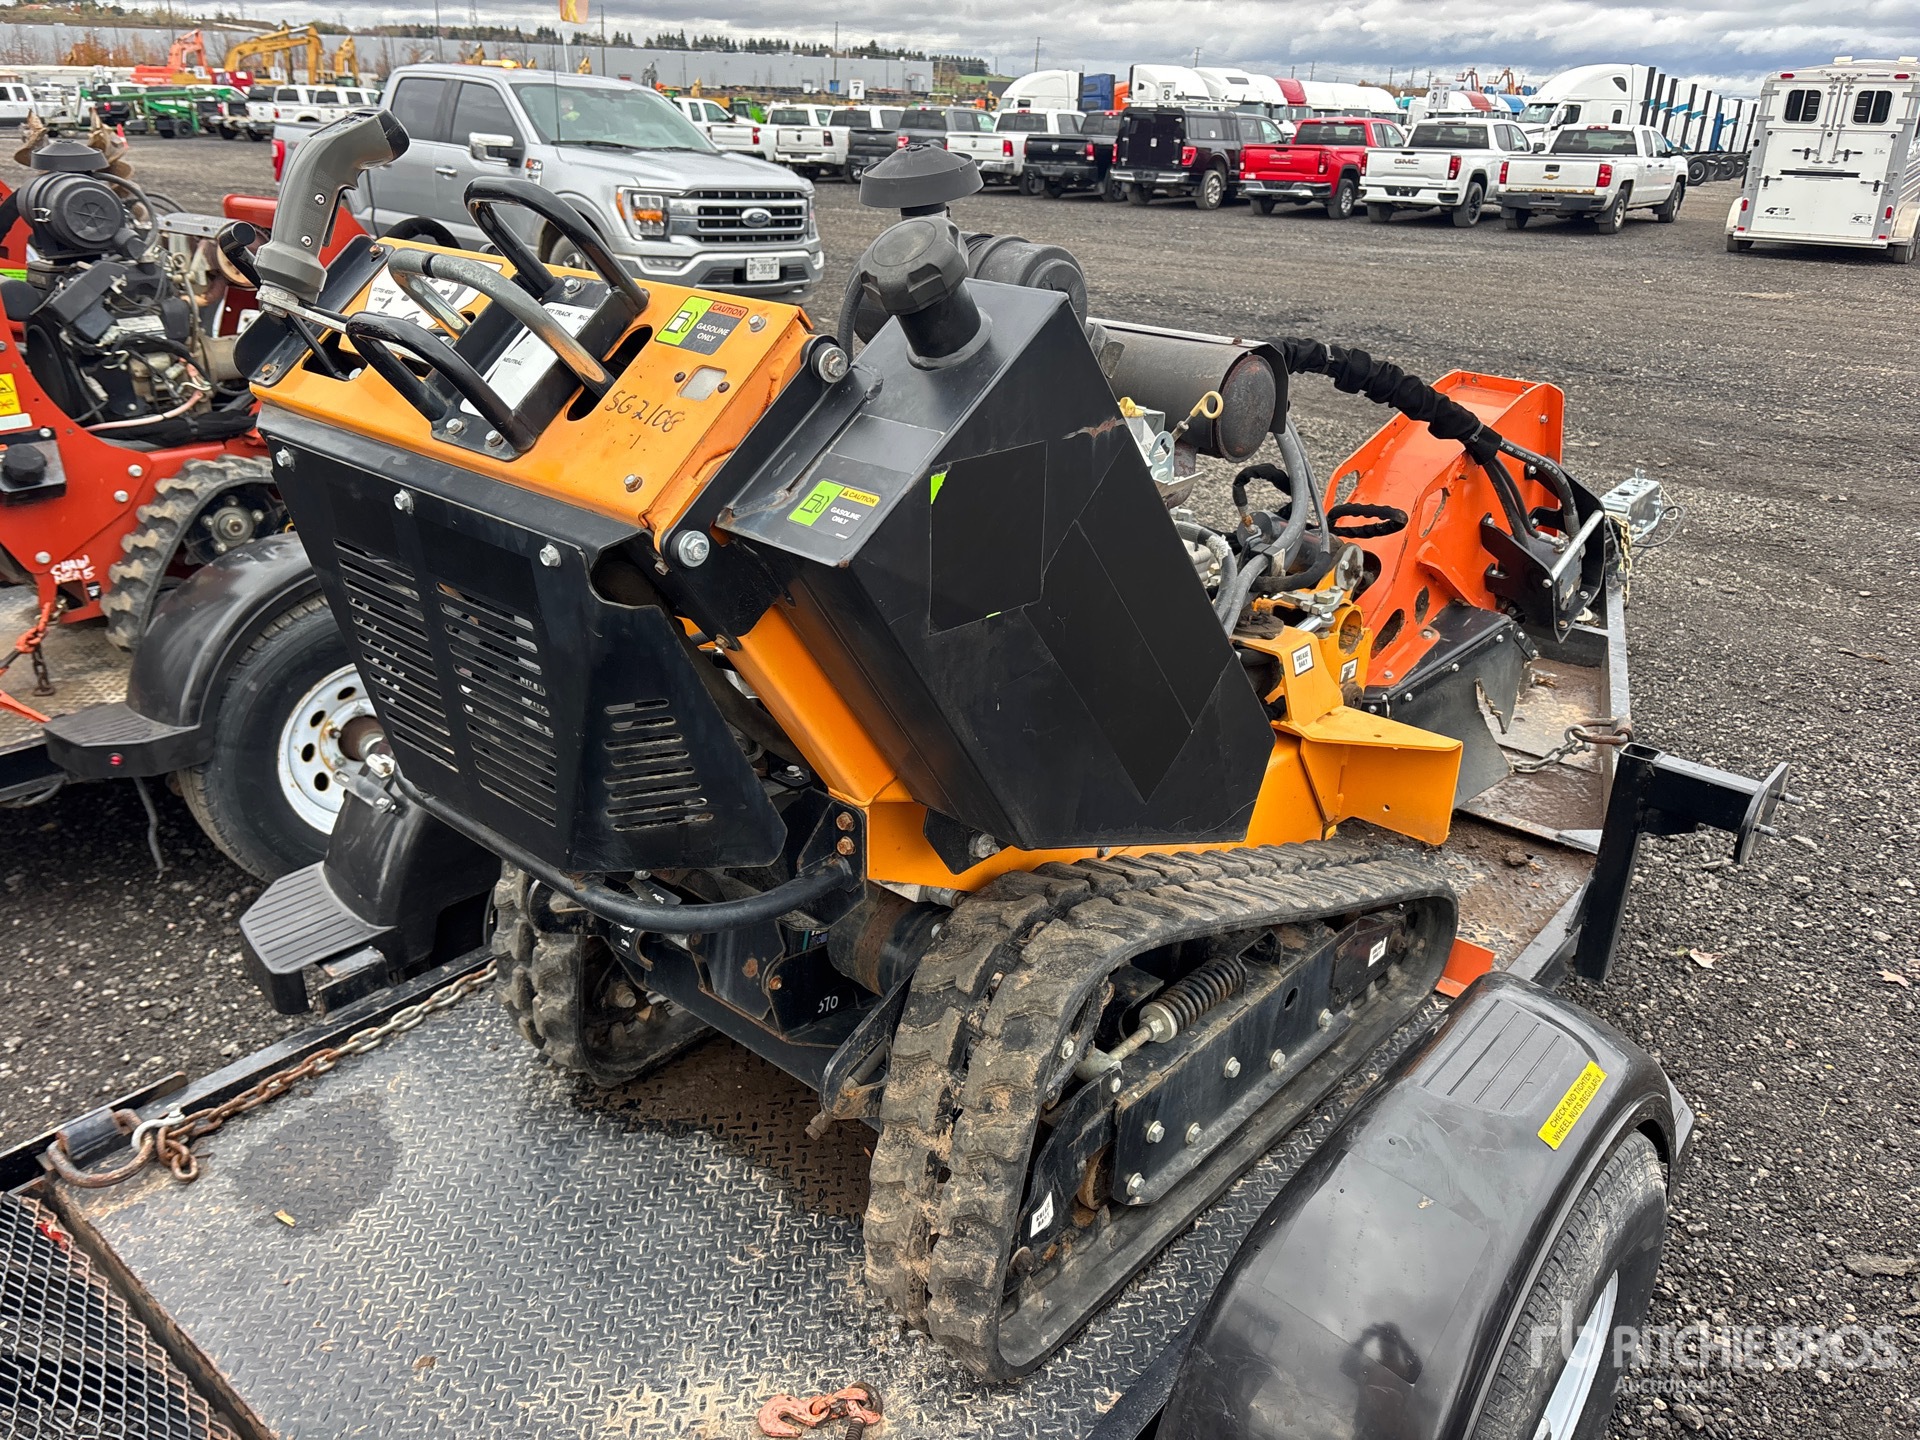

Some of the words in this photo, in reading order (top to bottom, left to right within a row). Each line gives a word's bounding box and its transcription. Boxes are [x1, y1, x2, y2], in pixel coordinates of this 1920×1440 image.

[853, 85, 861, 95] 7
[1163, 89, 1171, 101] 8
[1432, 91, 1438, 104] 9
[555, 309, 573, 318] TRACK
[712, 303, 744, 317] CAUTION
[696, 322, 730, 336] GASOLINE
[697, 332, 717, 342] ONLY
[503, 357, 523, 366] NEUTRAL
[848, 491, 877, 505] CAUTION
[830, 507, 861, 521] GASOLINE
[831, 516, 850, 525] ONLY
[1549, 1105, 1569, 1128] CHECK
[1565, 1093, 1577, 1108] AND
[1574, 1071, 1593, 1095] TIGHTEN
[1552, 1119, 1573, 1141] WHEEL
[1568, 1102, 1584, 1119] NUTS
[1579, 1073, 1602, 1105] REGULARLY
